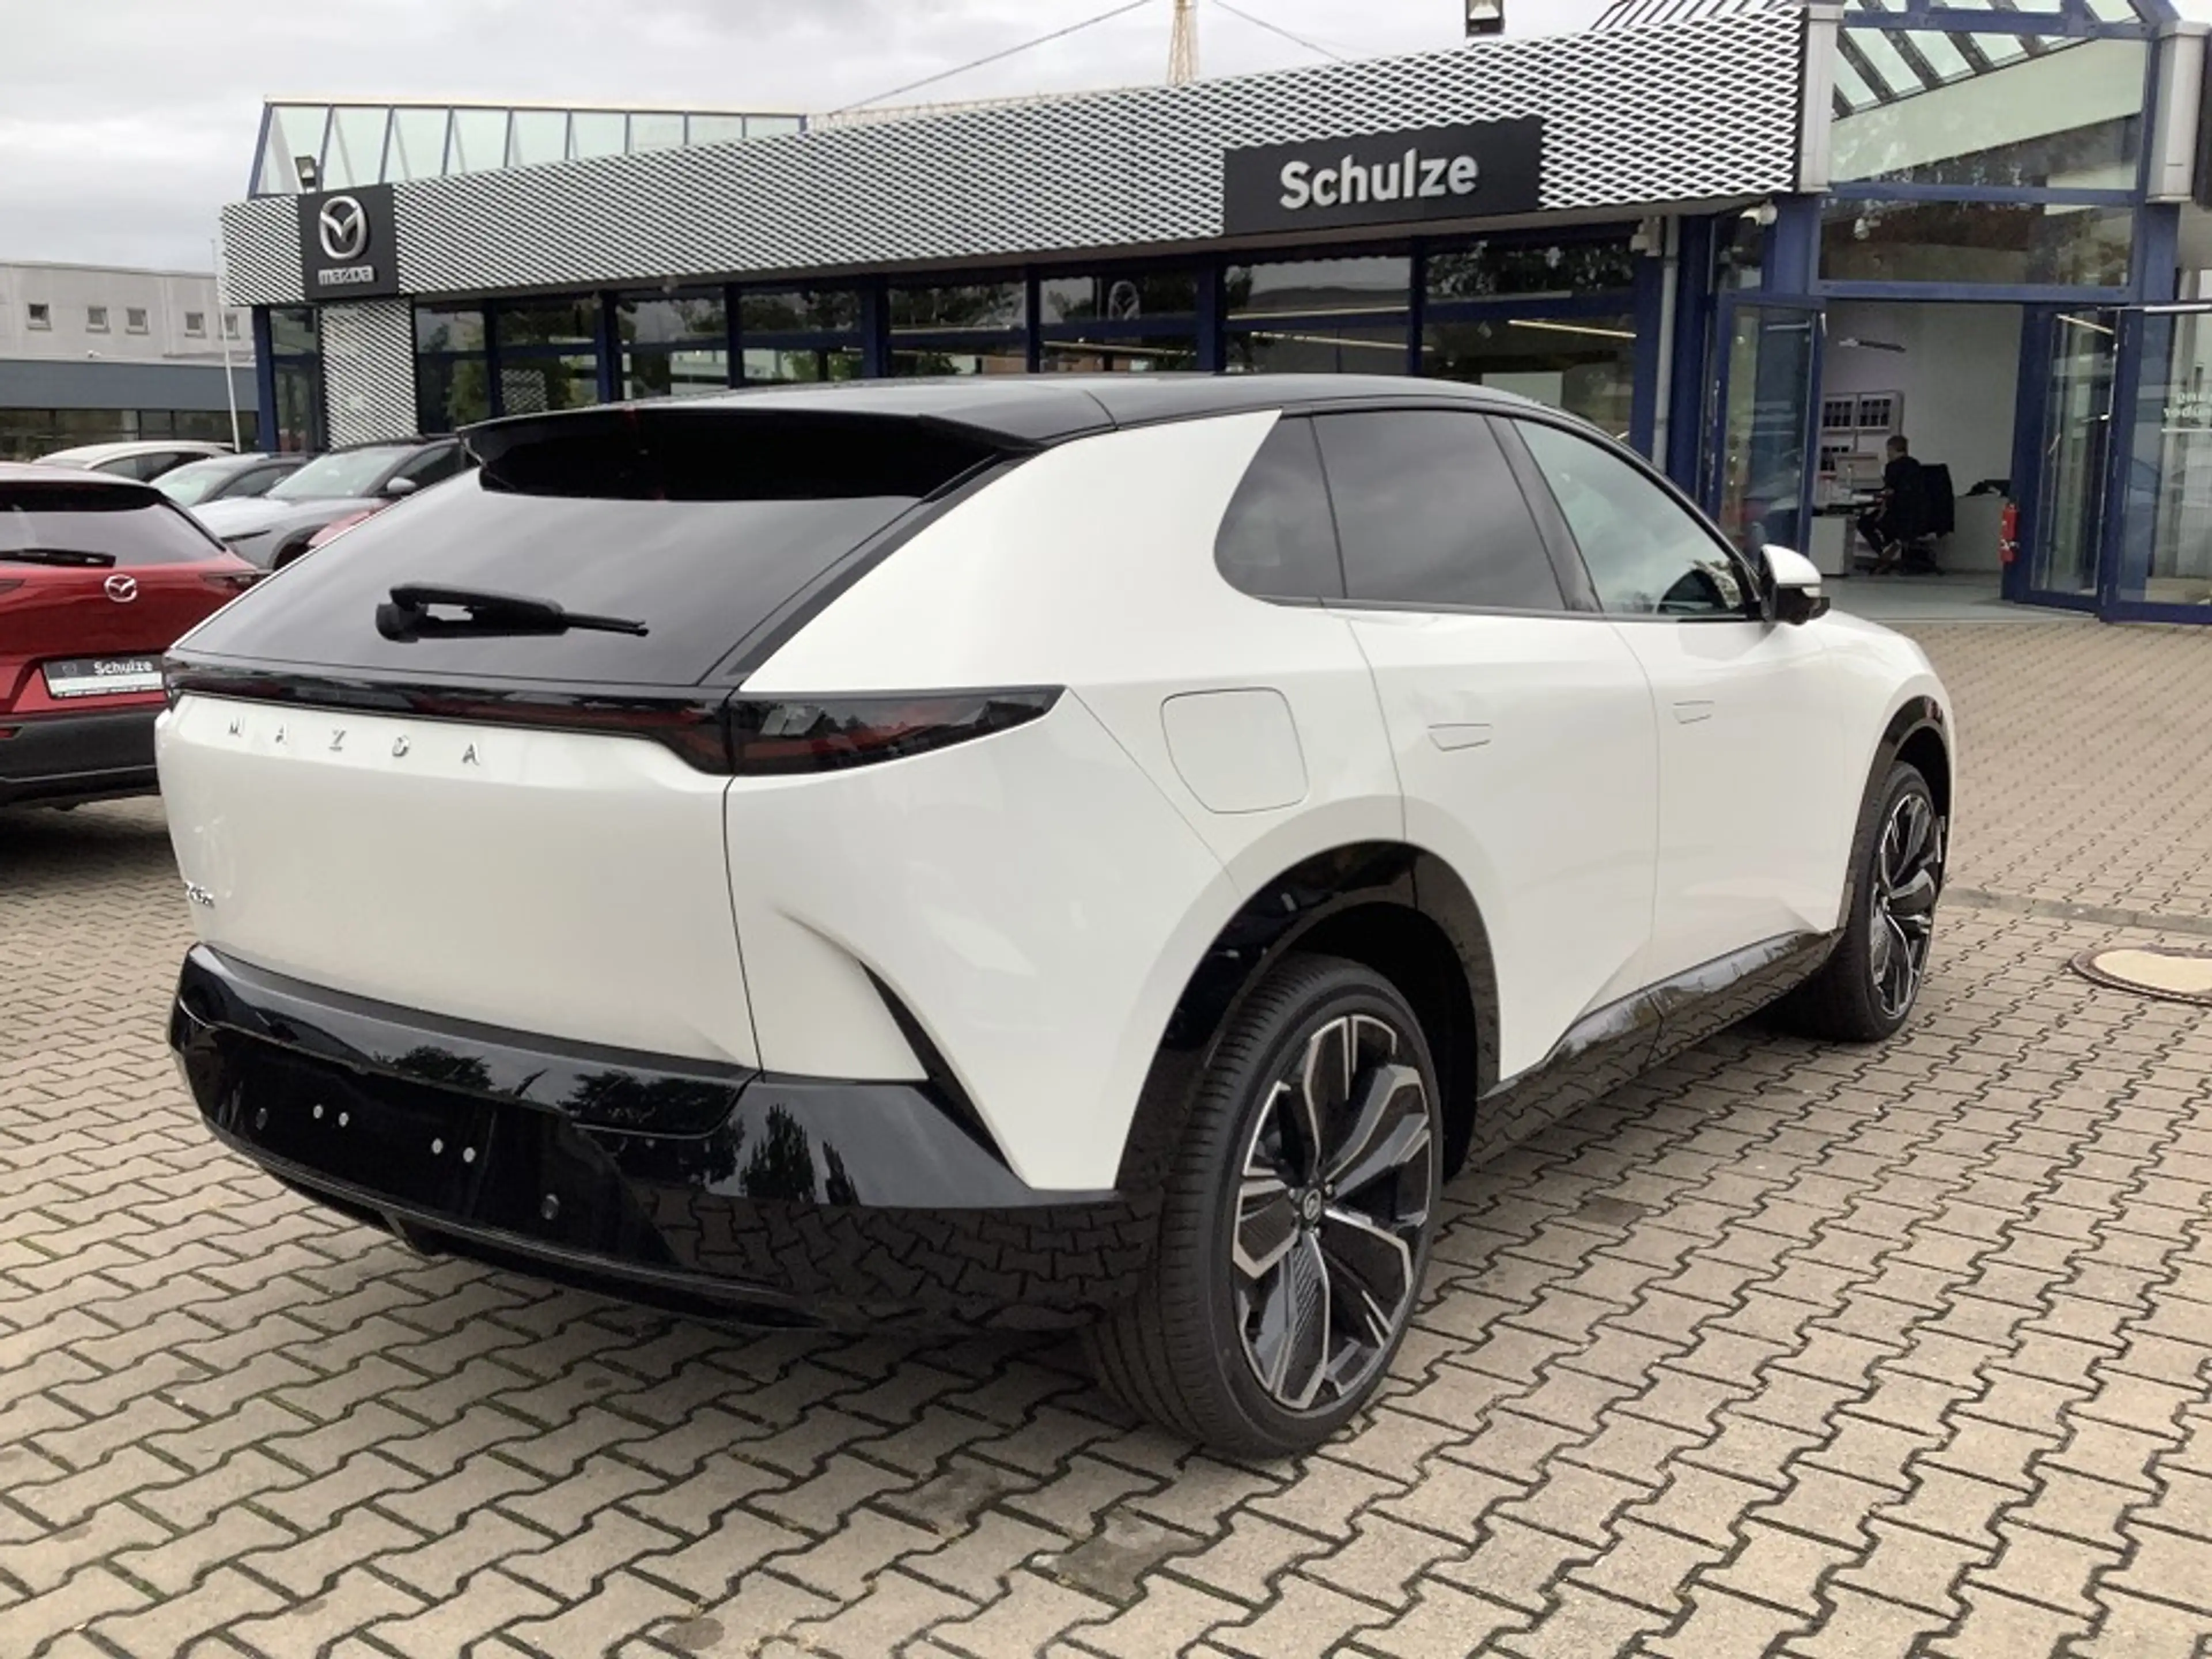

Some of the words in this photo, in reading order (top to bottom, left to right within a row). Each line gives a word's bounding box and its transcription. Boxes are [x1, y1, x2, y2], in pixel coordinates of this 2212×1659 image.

[1280, 147, 1478, 210] Schulze
[318, 264, 374, 286] mazda
[94, 659, 154, 676] Schulze
[228, 718, 480, 766] MAZDA
